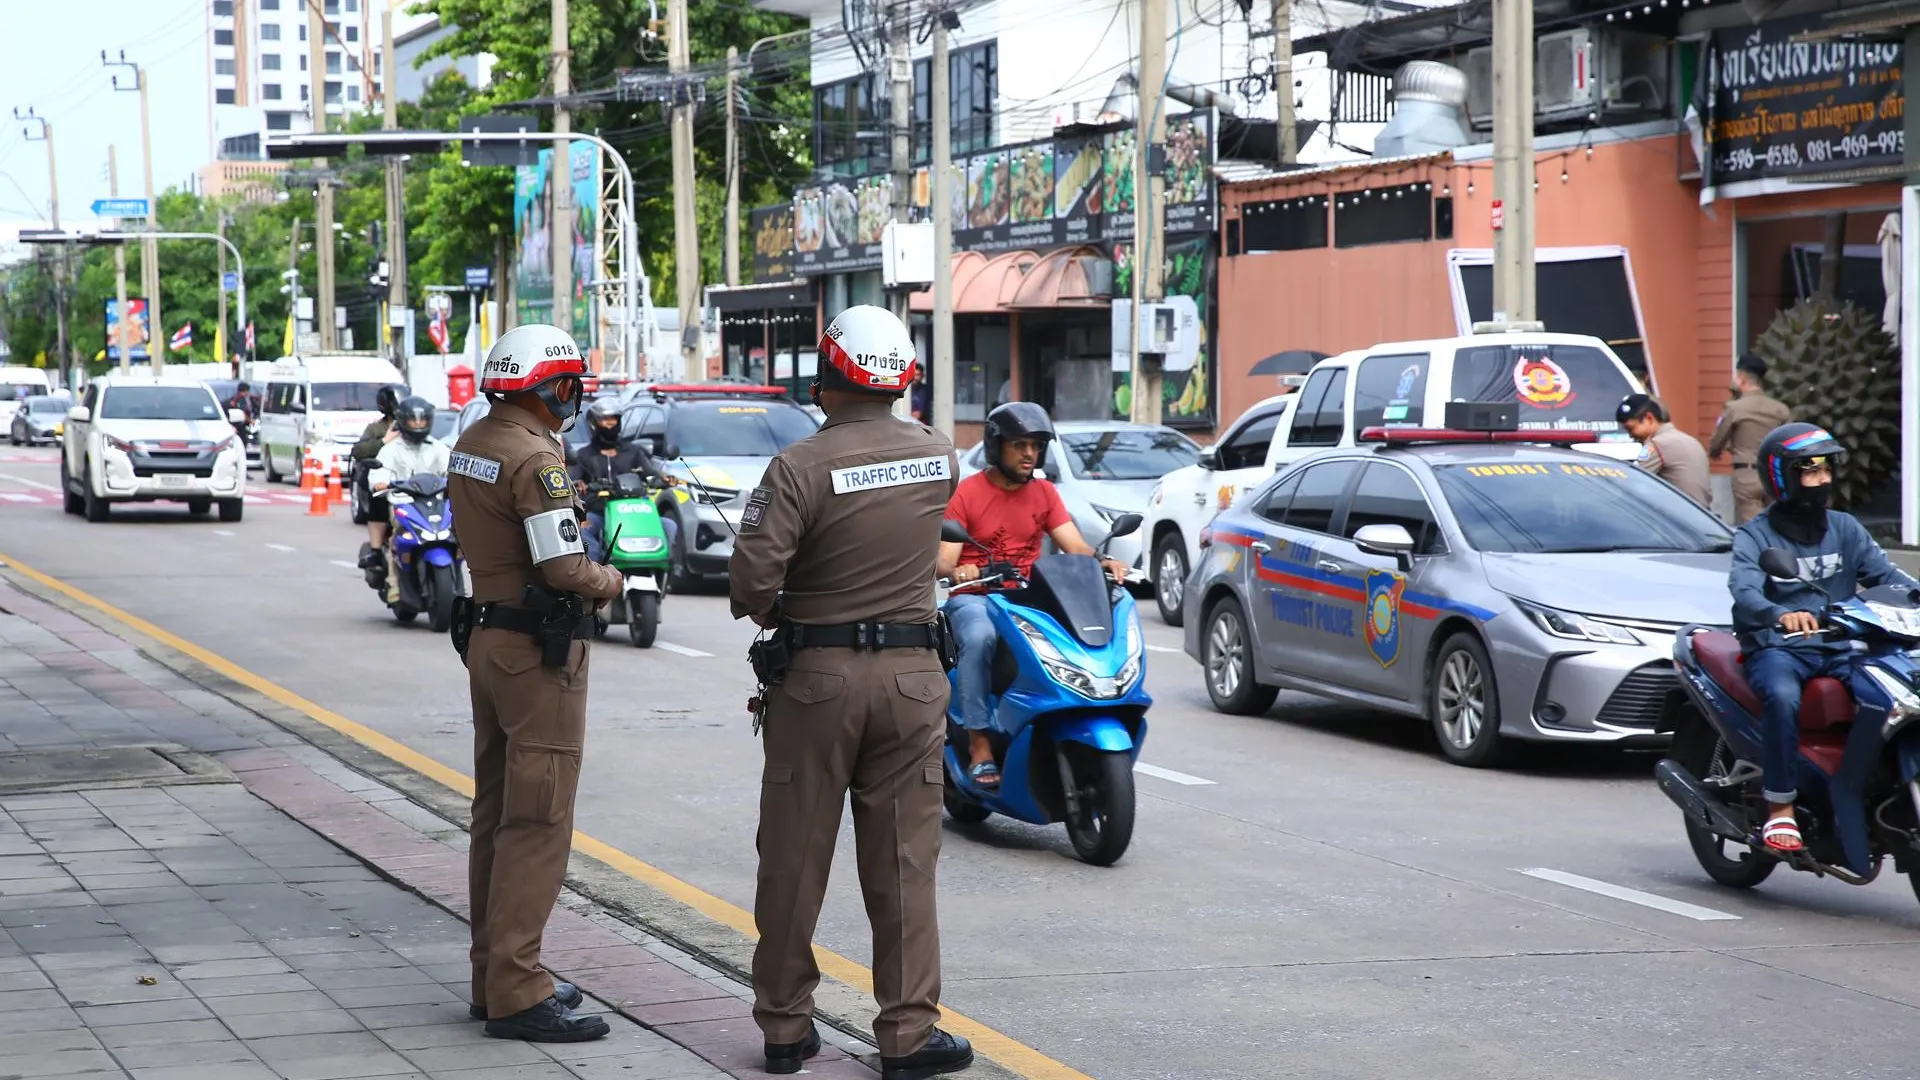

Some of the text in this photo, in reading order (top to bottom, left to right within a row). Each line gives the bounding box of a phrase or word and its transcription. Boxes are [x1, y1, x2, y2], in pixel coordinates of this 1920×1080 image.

[545, 344, 573, 357] 6018
[842, 460, 943, 488] TRAFFIC POLICE
[1466, 465, 1629, 479] TOURIST POLICE
[1316, 602, 1355, 637] POLICE
